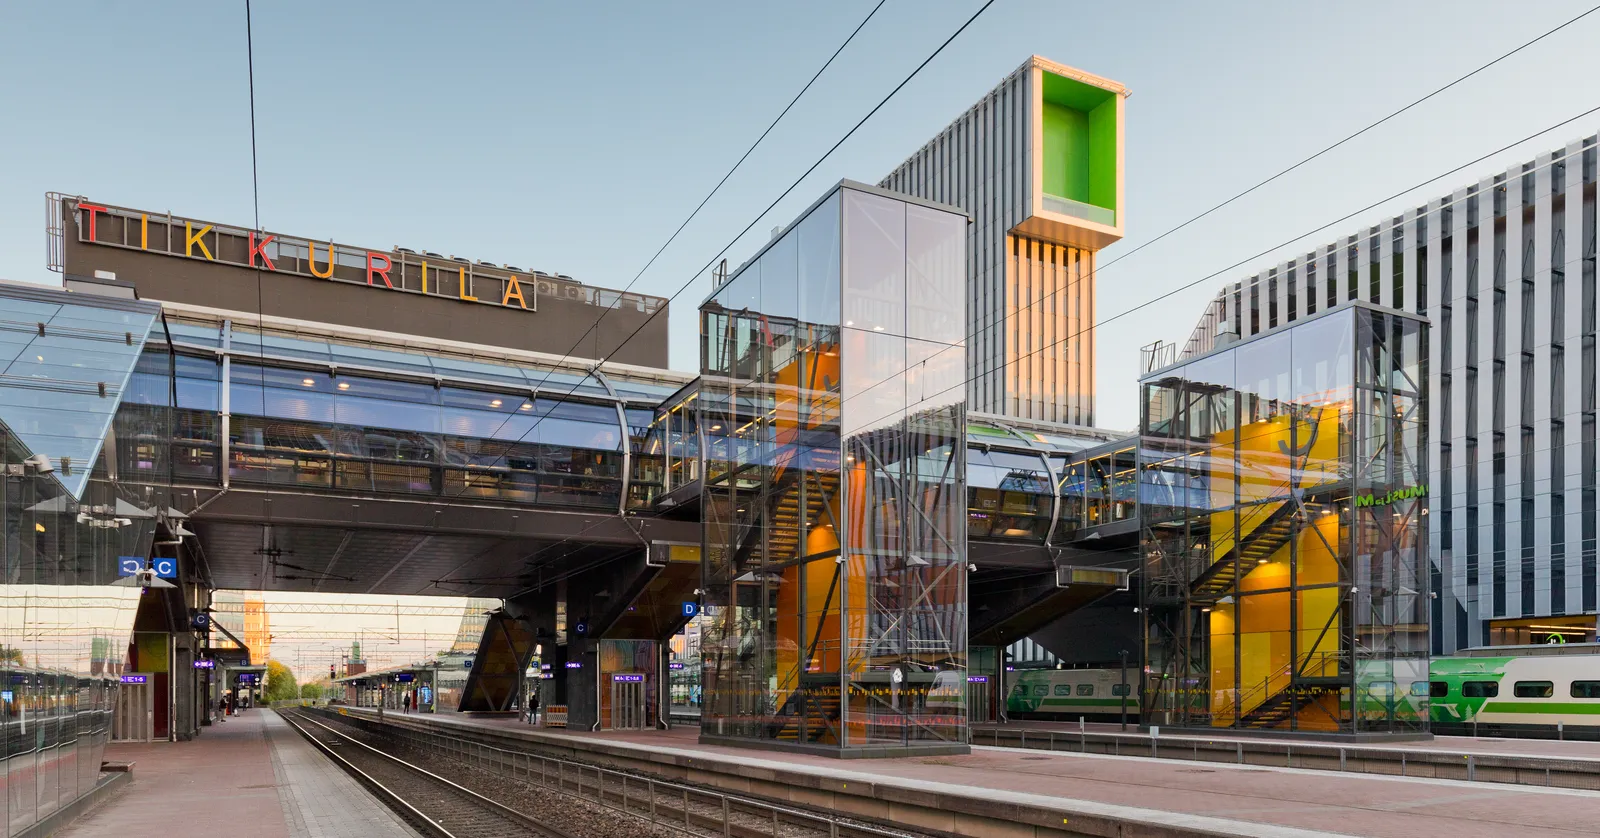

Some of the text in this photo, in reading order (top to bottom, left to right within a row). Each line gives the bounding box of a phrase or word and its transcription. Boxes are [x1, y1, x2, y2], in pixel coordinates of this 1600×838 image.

[79, 202, 527, 309] TIKKURILA
[158, 561, 172, 575] C
[685, 604, 694, 614] D
[196, 615, 206, 624] C
[577, 624, 585, 632] C
